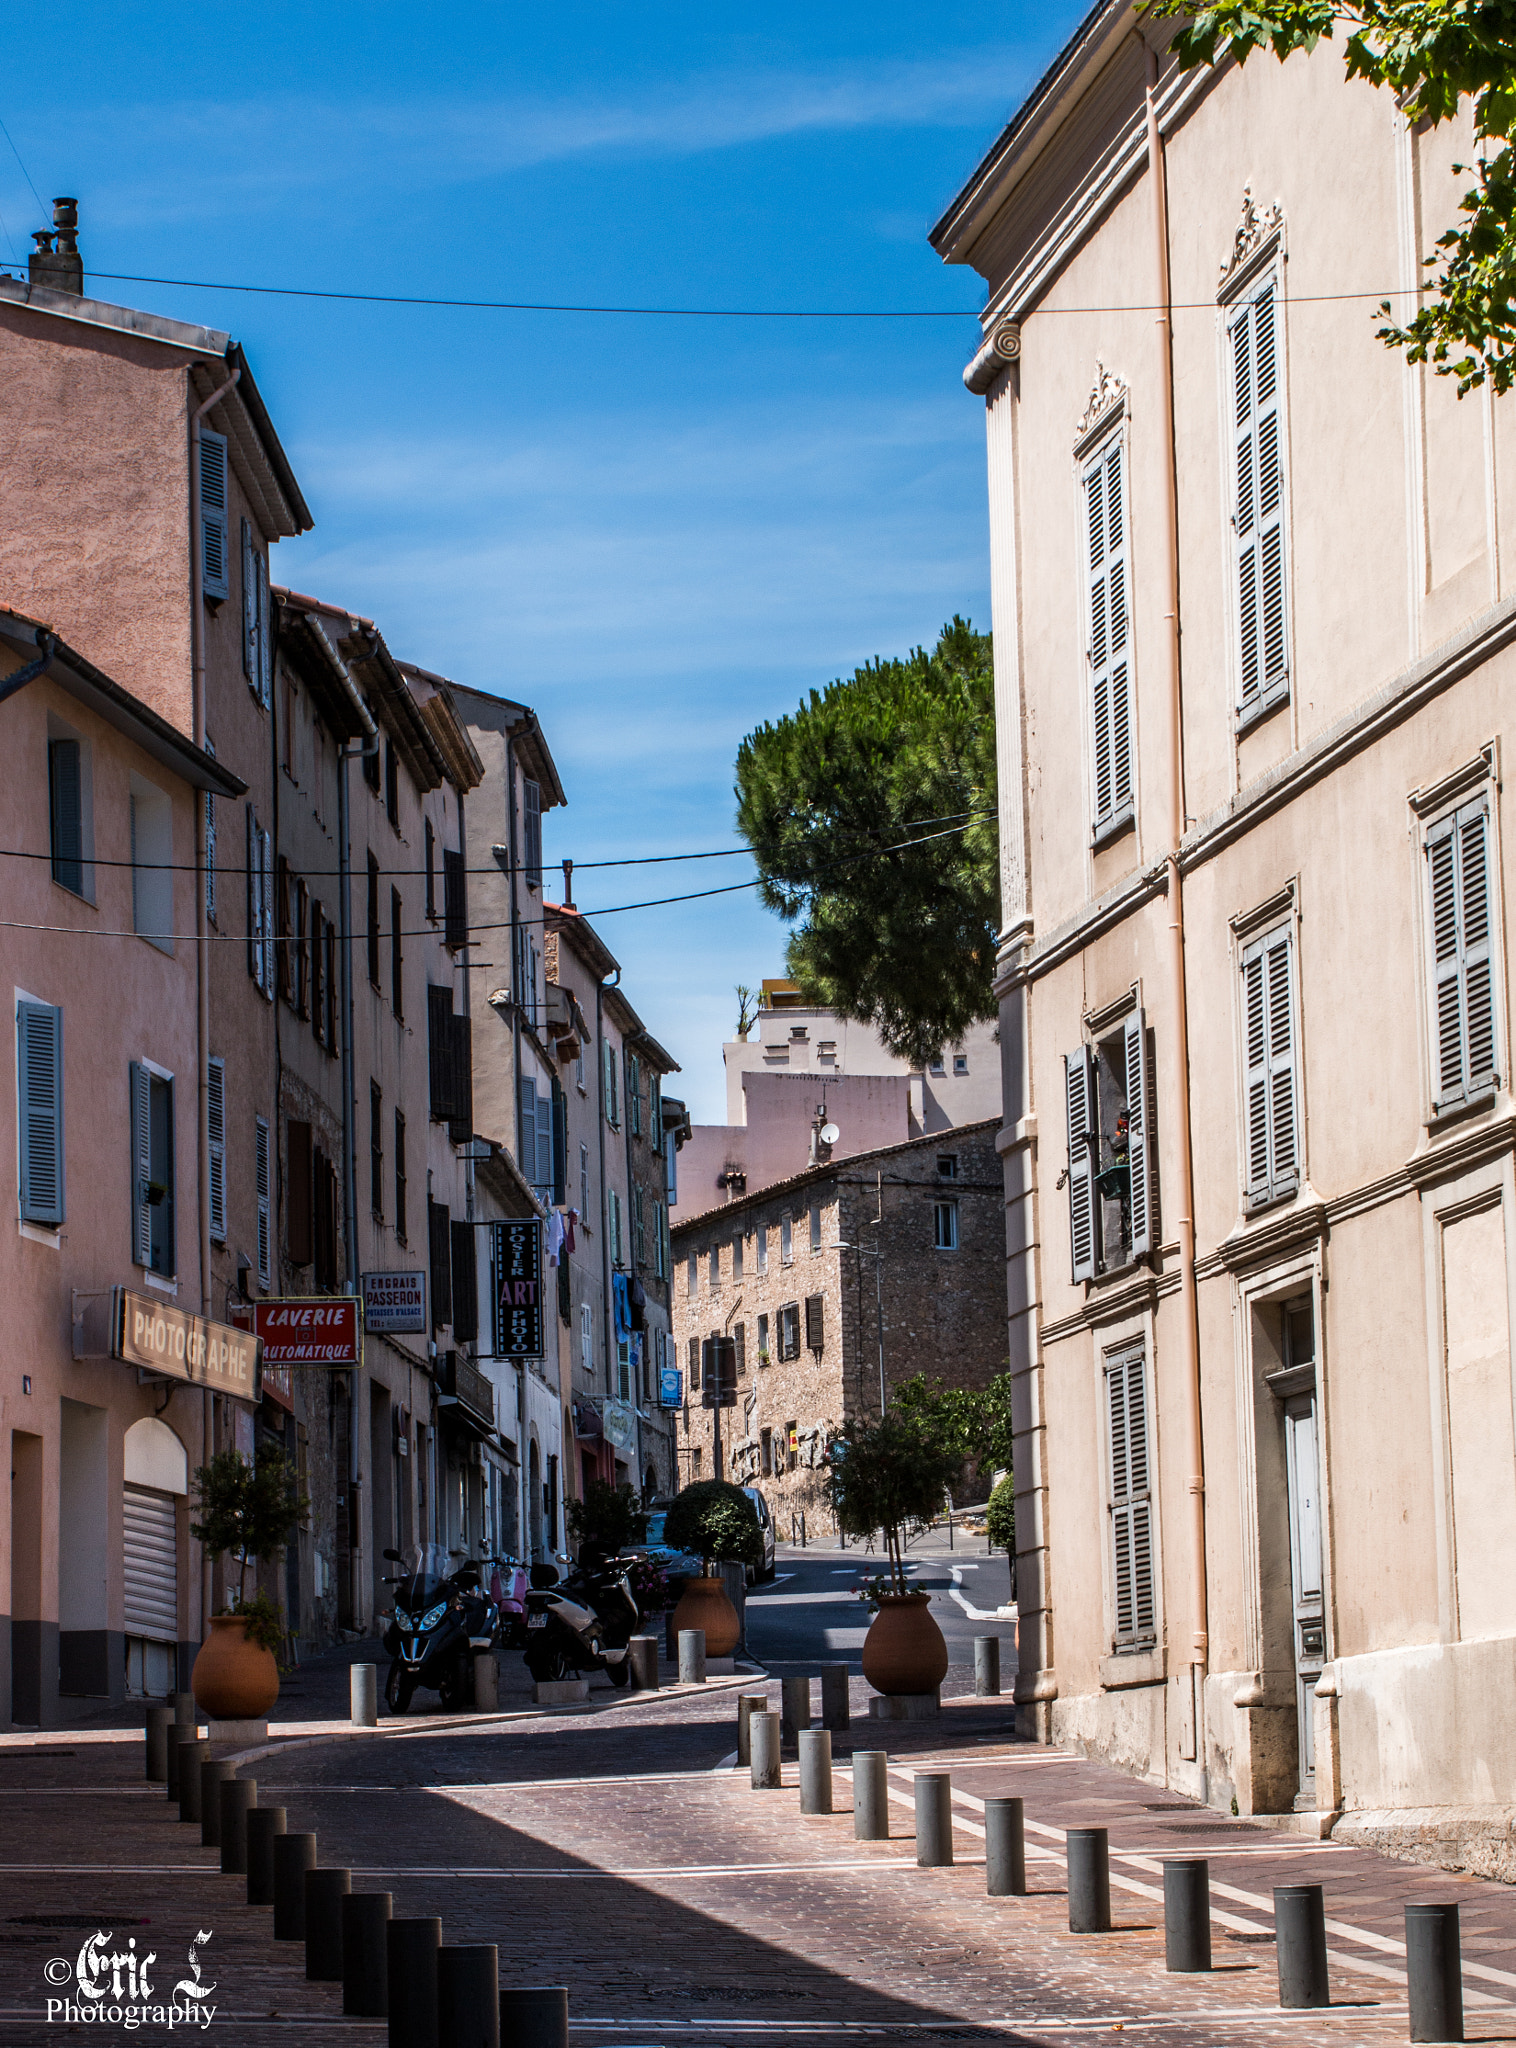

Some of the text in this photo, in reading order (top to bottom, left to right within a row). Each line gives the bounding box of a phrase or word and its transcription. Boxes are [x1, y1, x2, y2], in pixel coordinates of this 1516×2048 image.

[509, 1226, 526, 1276] POSTER
[371, 1277, 417, 1289] ENGRAIS
[367, 1291, 421, 1306] PASSERON
[500, 1281, 537, 1305] ART
[266, 1308, 346, 1327] LAVERIE
[367, 1308, 394, 1316] POTASSES
[510, 1310, 528, 1352] PHOTO
[134, 1311, 247, 1380] PHOTOGRAPHE
[263, 1344, 351, 1360] AUTOMATIQUE
